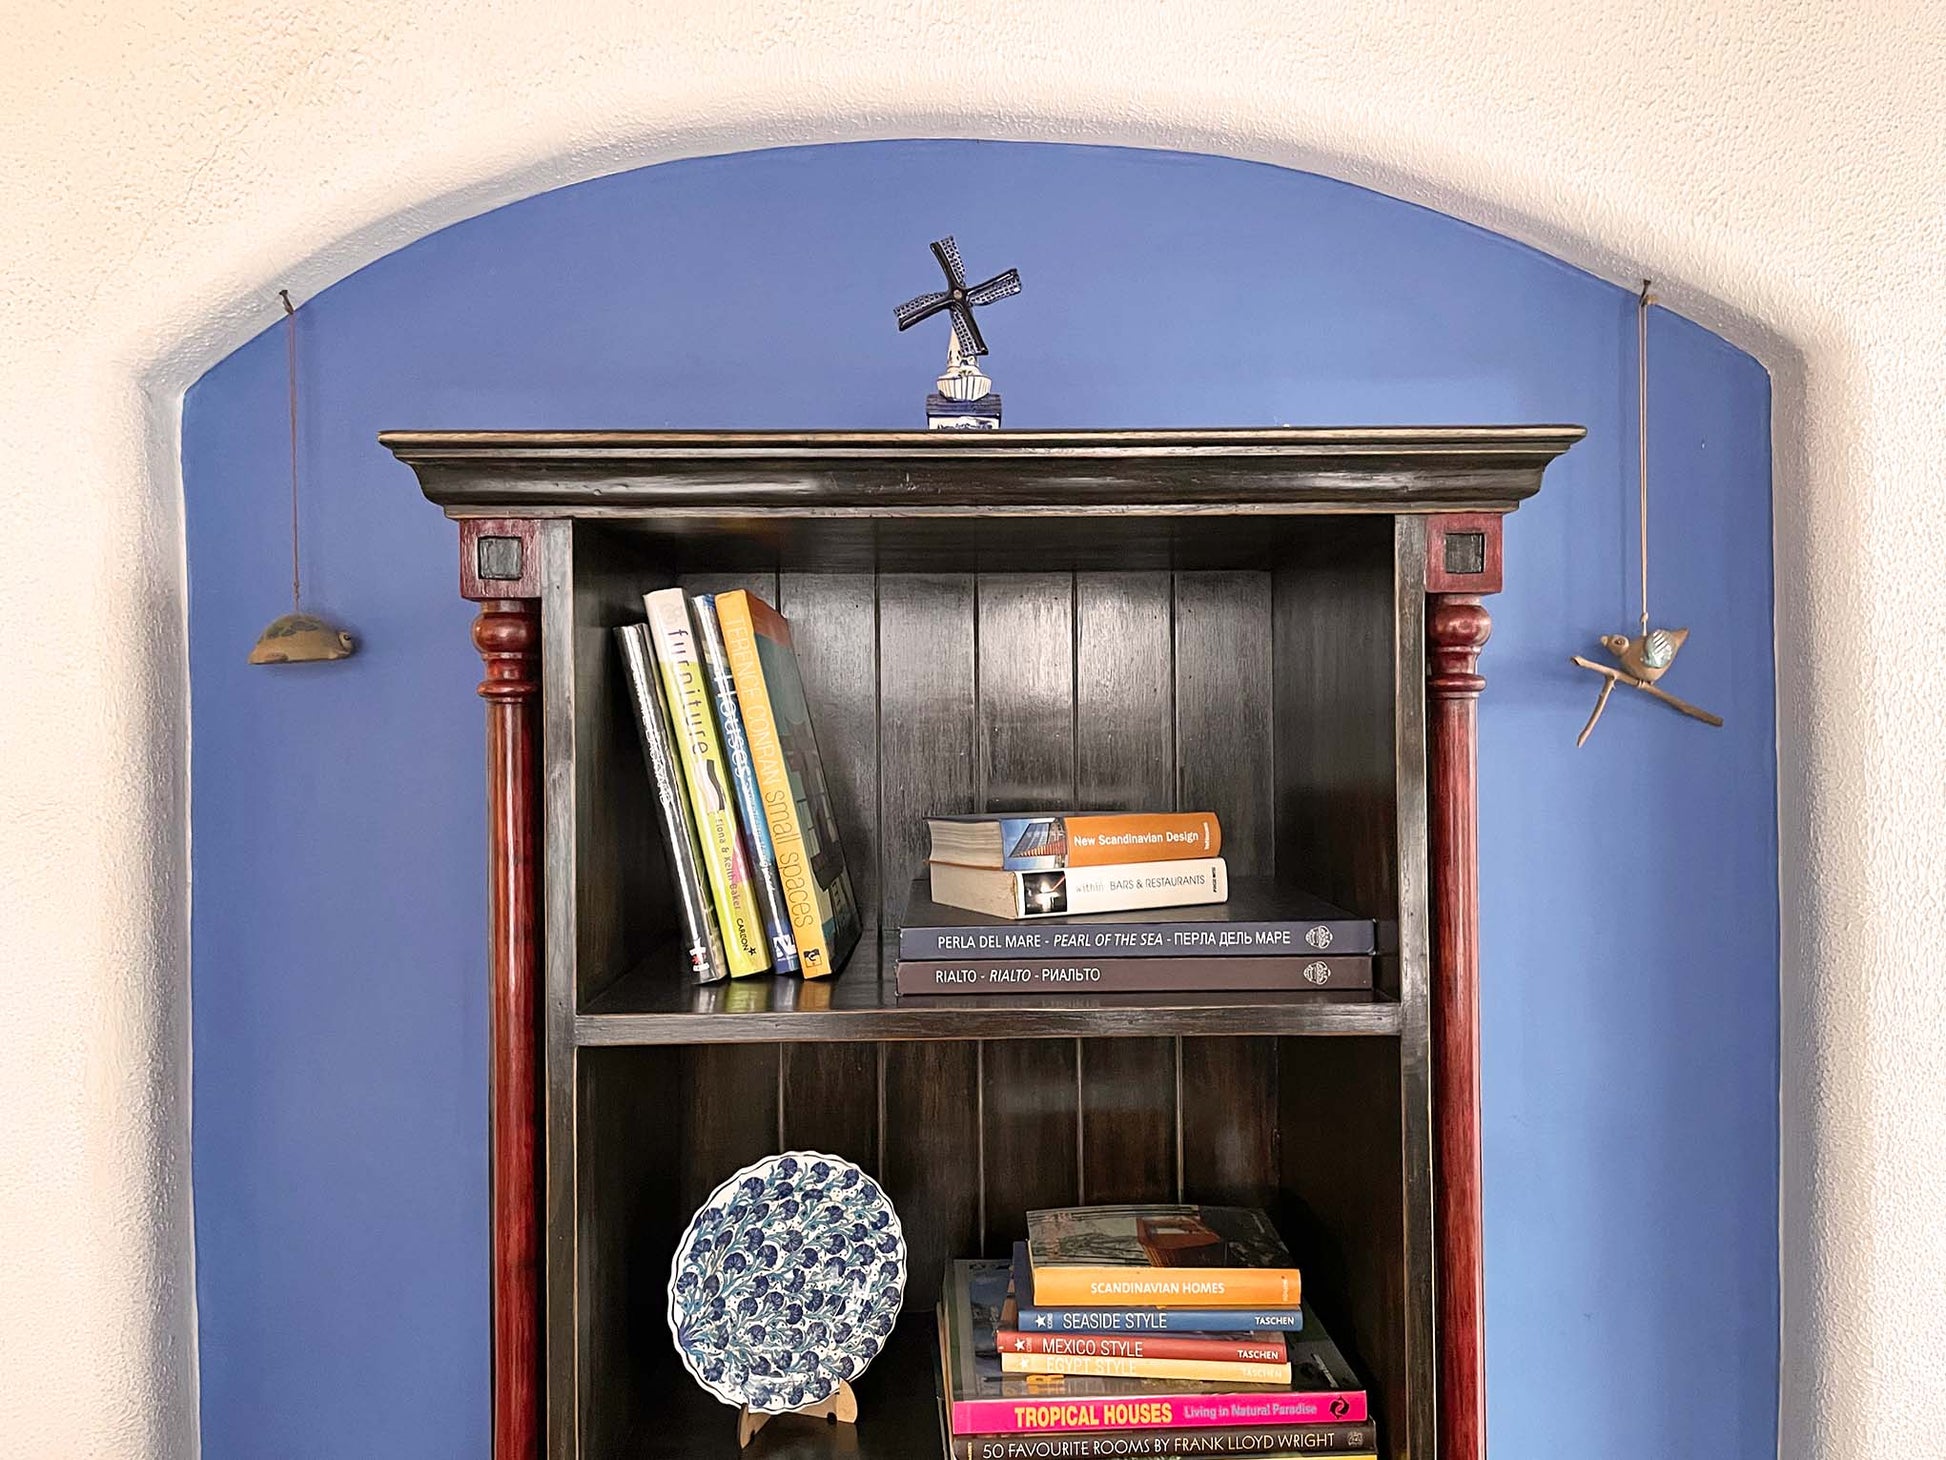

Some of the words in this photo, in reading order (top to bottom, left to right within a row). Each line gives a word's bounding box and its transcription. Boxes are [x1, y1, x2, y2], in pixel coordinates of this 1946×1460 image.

[668, 628, 708, 754] furniture
[725, 617, 756, 698] TERENCE
[746, 704, 781, 785] CONRAN
[714, 674, 750, 778] Houses
[764, 790, 802, 845] small
[1073, 835, 1096, 847] New
[1098, 832, 1163, 846] Scandinavian
[1166, 831, 1200, 845] Design
[715, 818, 727, 844] Fiona
[723, 853, 734, 881] Keith
[729, 882, 742, 910] Baker
[779, 852, 814, 928] spaces
[1109, 879, 1134, 892] BARS
[1136, 879, 1143, 889] &
[1145, 874, 1205, 888] RESTAURANTS
[937, 935, 976, 949] PERLA
[979, 935, 1002, 948] DEL
[1005, 934, 1042, 948] MARE
[1053, 933, 1091, 947] PEARL
[1094, 933, 1112, 947] OF
[1114, 932, 1138, 946] THE
[1140, 932, 1163, 946] SEA
[1174, 931, 1217, 945] ПЕРЛА
[1218, 931, 1252, 947] ДЕЛЬ
[1255, 930, 1291, 945] МАРЕ
[935, 969, 977, 983] RIALTO
[989, 968, 1032, 983] RIALTO
[1041, 967, 1101, 983] РИАЛЬТО
[1090, 1282, 1180, 1295] SCANDINAVIAN
[1182, 1282, 1225, 1294] HOMES
[1063, 1312, 1121, 1329] SEASIDE
[1125, 1312, 1168, 1329] STYLE
[1255, 1316, 1295, 1326] TASCHEN
[1042, 1337, 1096, 1356] MEXICO
[1100, 1339, 1144, 1358] STYLE
[1237, 1349, 1279, 1360] TASCHEN
[1046, 1357, 1089, 1373] EGYPT
[1096, 1358, 1137, 1374] STYLE
[1014, 1406, 1100, 1428] TROPICAL
[1103, 1402, 1173, 1426] HOUSES
[1183, 1405, 1217, 1419] Living
[1219, 1404, 1229, 1416] in
[1231, 1403, 1270, 1417] Natural
[1272, 1402, 1318, 1416] Paradise
[982, 1443, 1004, 1459] 50
[1007, 1440, 1090, 1458] FAVOURITE
[1093, 1438, 1150, 1455] ROOMS
[1154, 1438, 1171, 1453] BY
[1174, 1436, 1225, 1451] FRANK
[1228, 1434, 1274, 1450] LLOYD
[1277, 1432, 1335, 1448] WRIGHT
